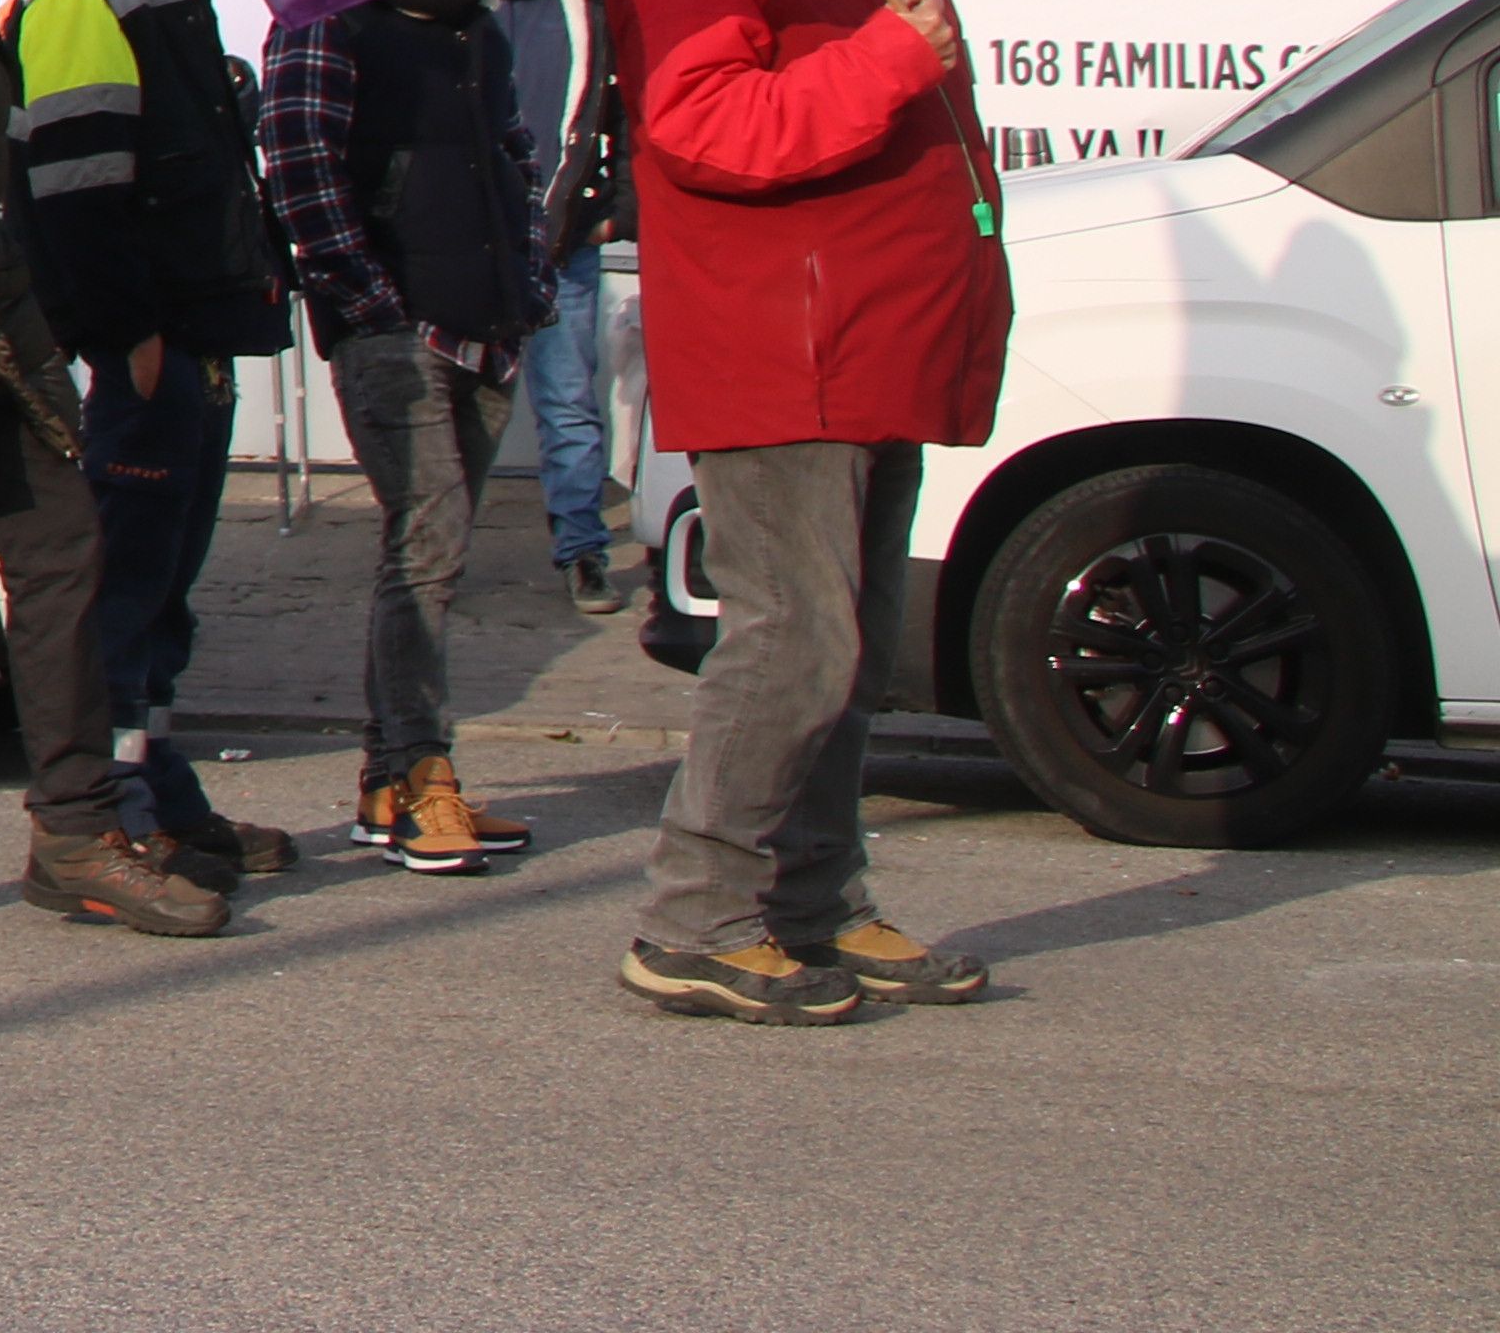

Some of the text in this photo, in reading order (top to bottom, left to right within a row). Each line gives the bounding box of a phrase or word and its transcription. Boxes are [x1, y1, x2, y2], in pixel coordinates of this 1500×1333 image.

[990, 39, 1060, 86] 168
[1075, 41, 1265, 90] FAMILIAS
[1068, 128, 1119, 159] YA
